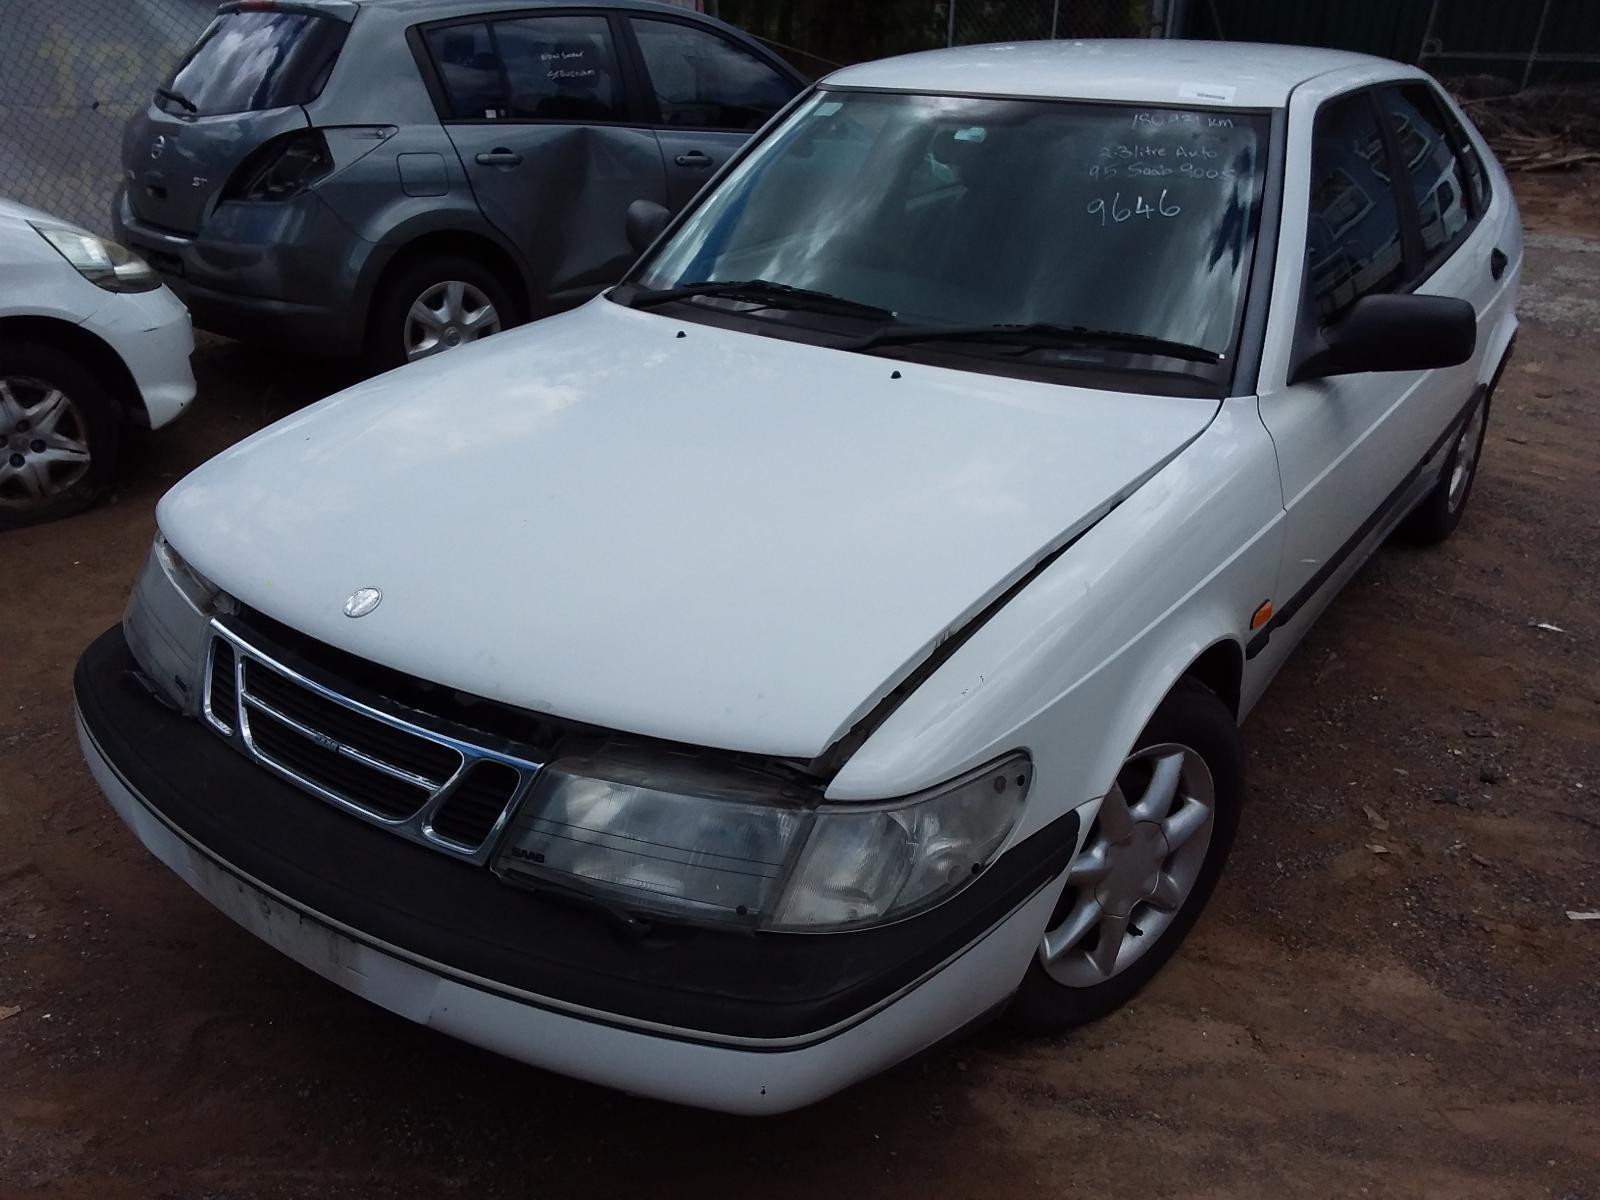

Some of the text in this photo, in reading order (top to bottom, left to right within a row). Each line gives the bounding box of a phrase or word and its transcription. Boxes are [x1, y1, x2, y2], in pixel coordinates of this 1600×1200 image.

[1176, 144, 1218, 160] Auto
[1128, 162, 1173, 178] Saab
[1087, 188, 1181, 226] 9646
[511, 847, 545, 864] SAAB
